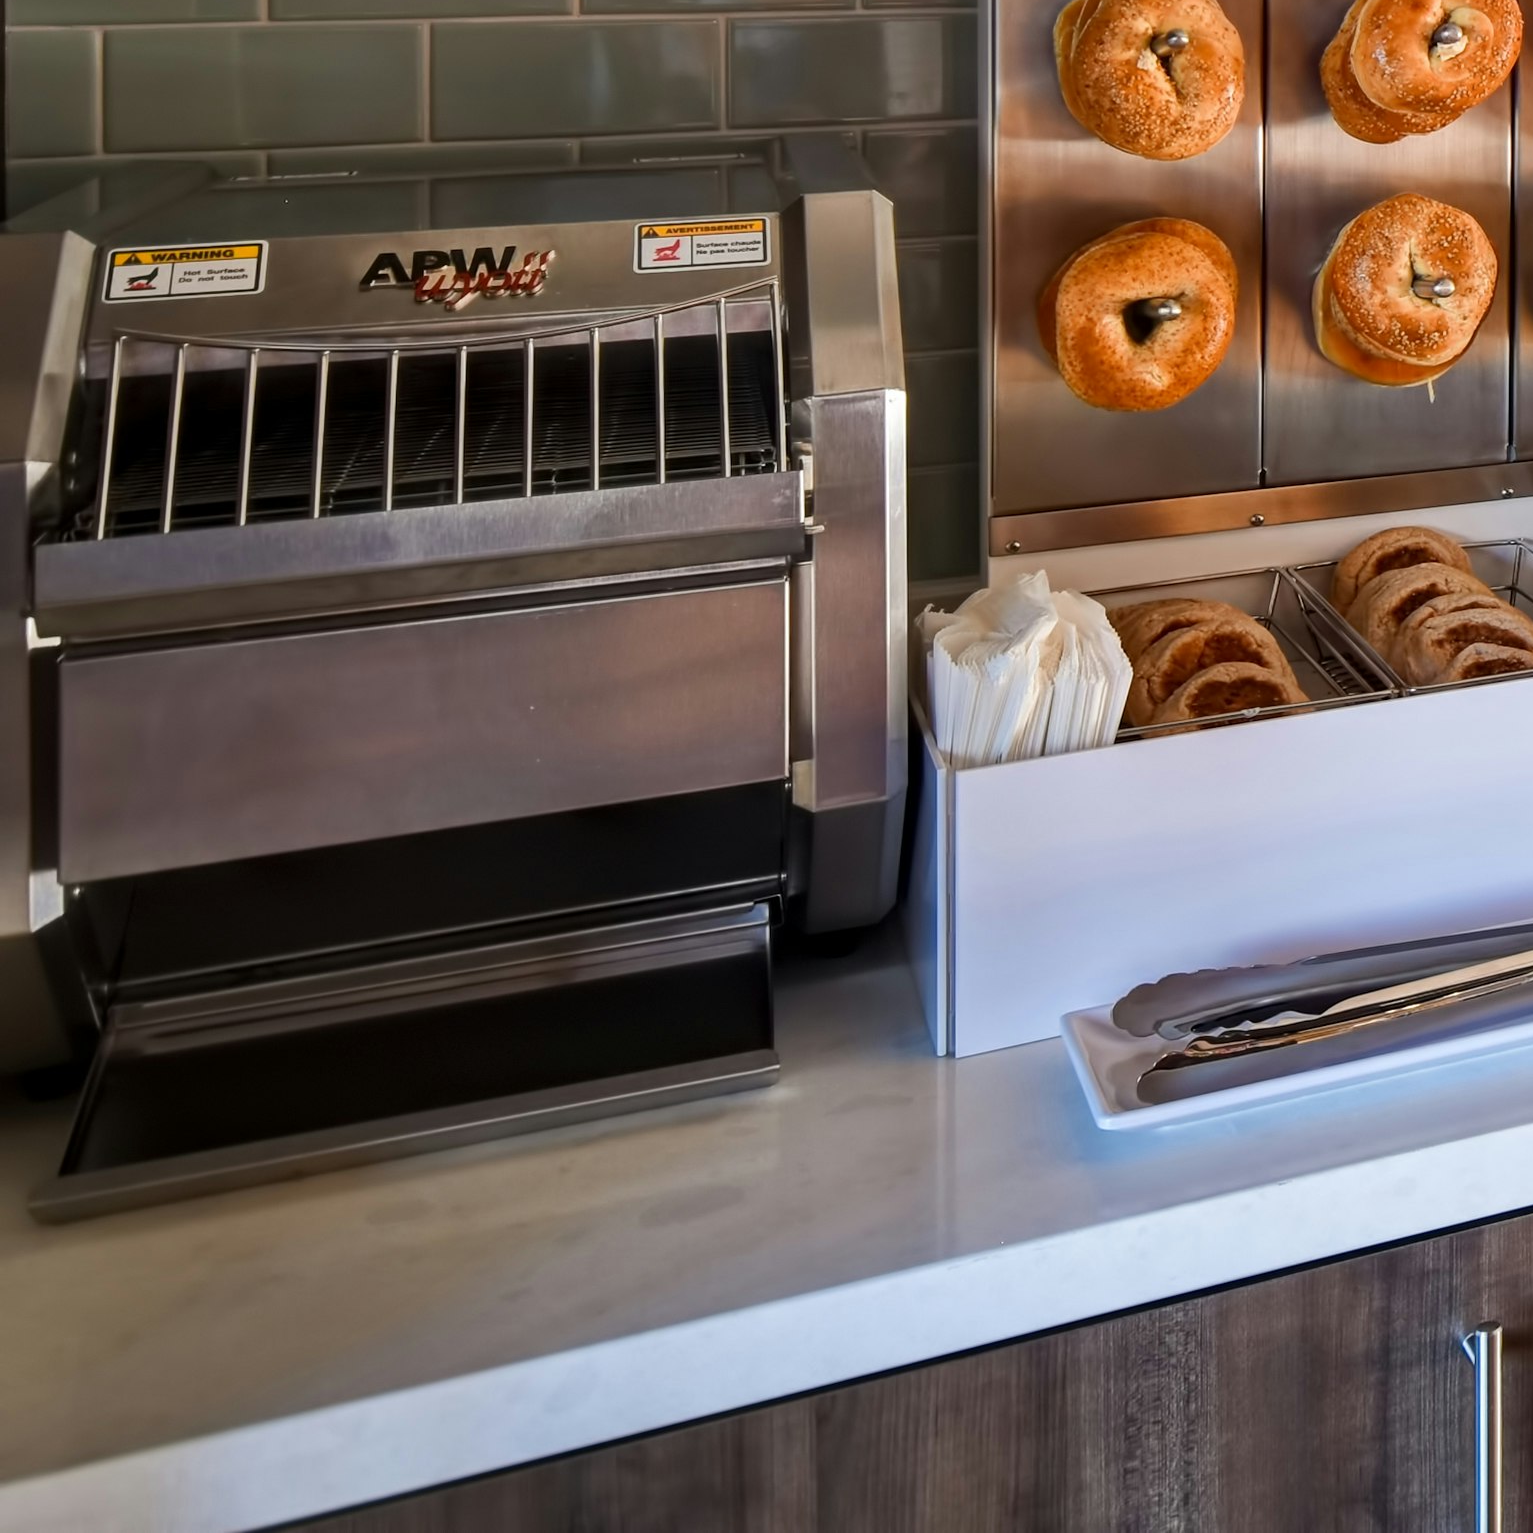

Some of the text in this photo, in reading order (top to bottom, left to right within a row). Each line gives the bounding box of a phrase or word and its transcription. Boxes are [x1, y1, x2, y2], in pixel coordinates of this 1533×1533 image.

[666, 223, 755, 235] AVERTISSEMENT
[151, 249, 235, 262] WARNING
[359, 246, 516, 291] APW
